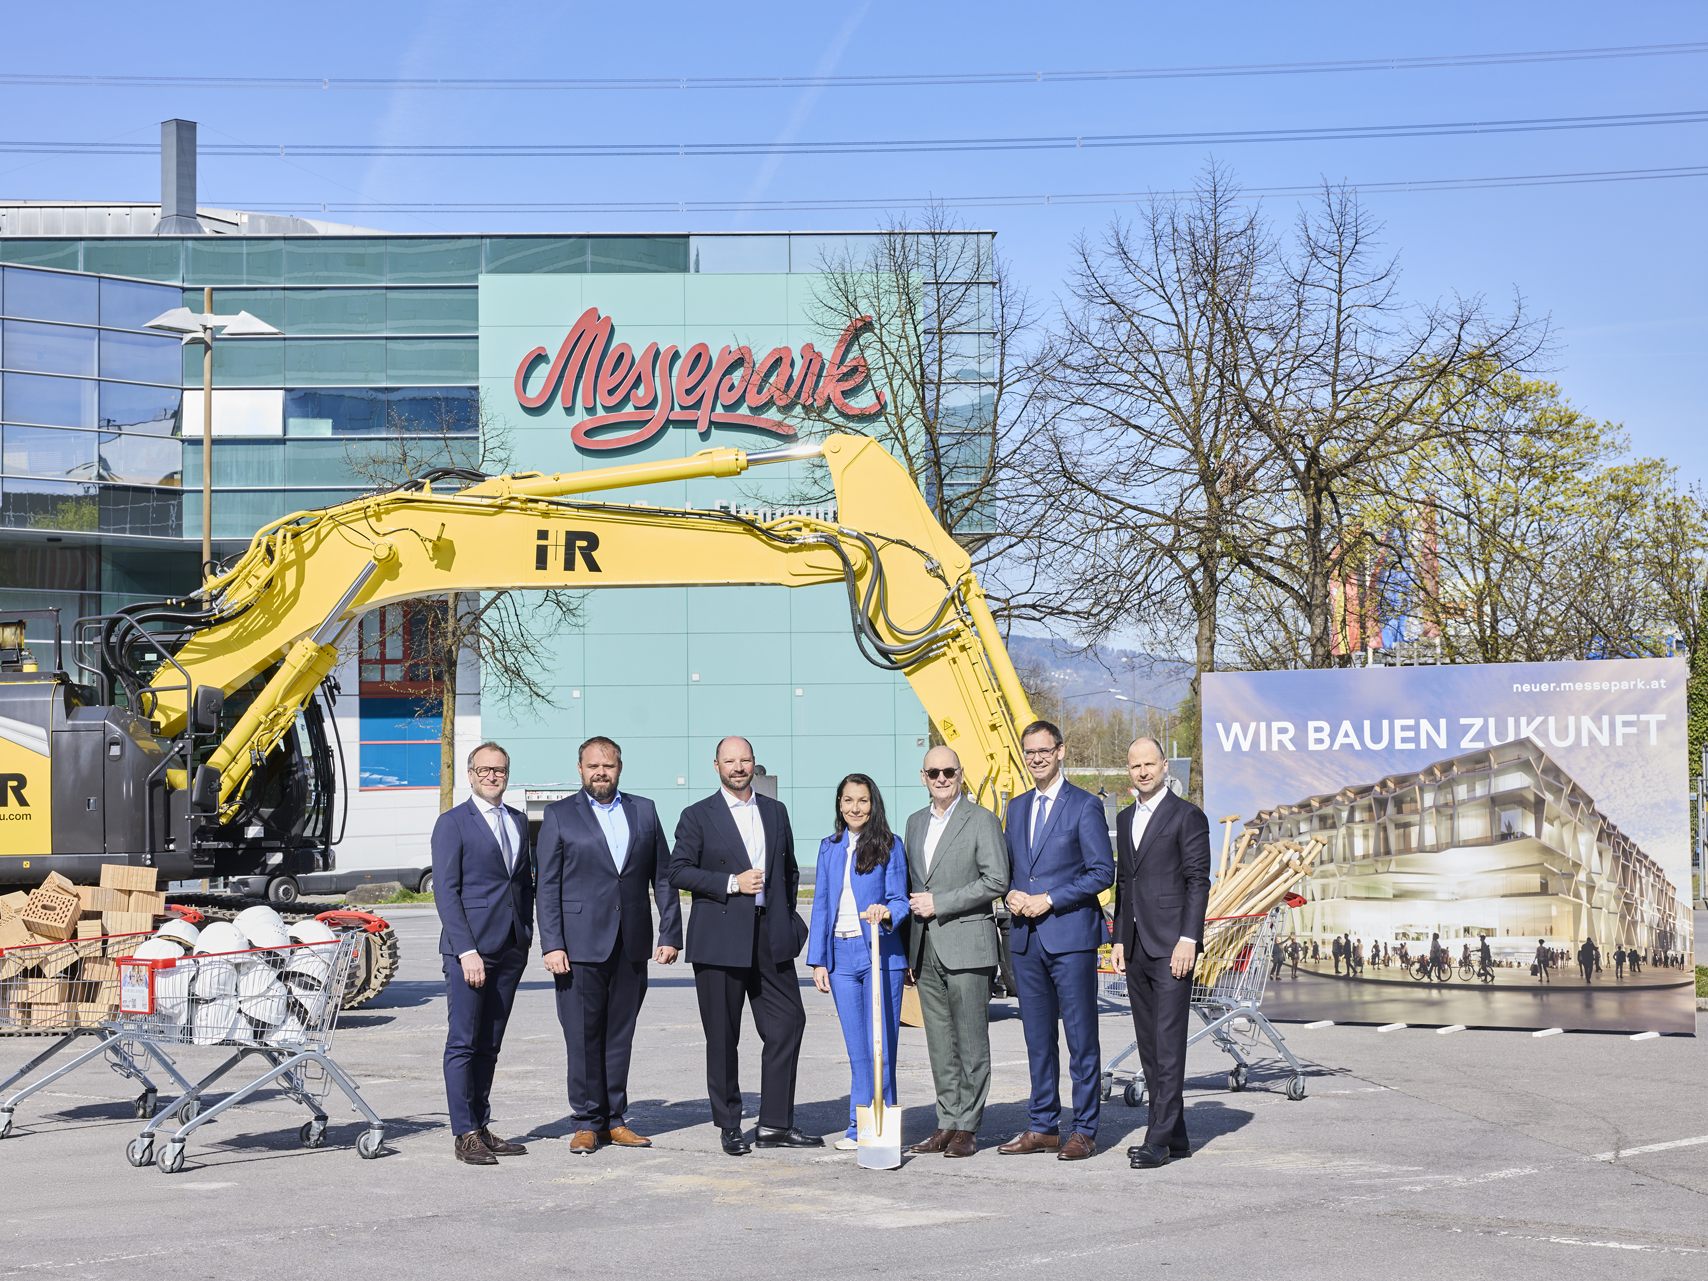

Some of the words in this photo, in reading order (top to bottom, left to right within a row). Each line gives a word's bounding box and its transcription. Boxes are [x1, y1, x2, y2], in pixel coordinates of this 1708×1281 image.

[514, 307, 887, 450] Messepark
[1513, 678, 1667, 693] neuer.messepark.at
[1216, 721, 1297, 752] WIR
[1307, 718, 1448, 751] BAUEN
[1459, 714, 1667, 750] ZUKUNFT
